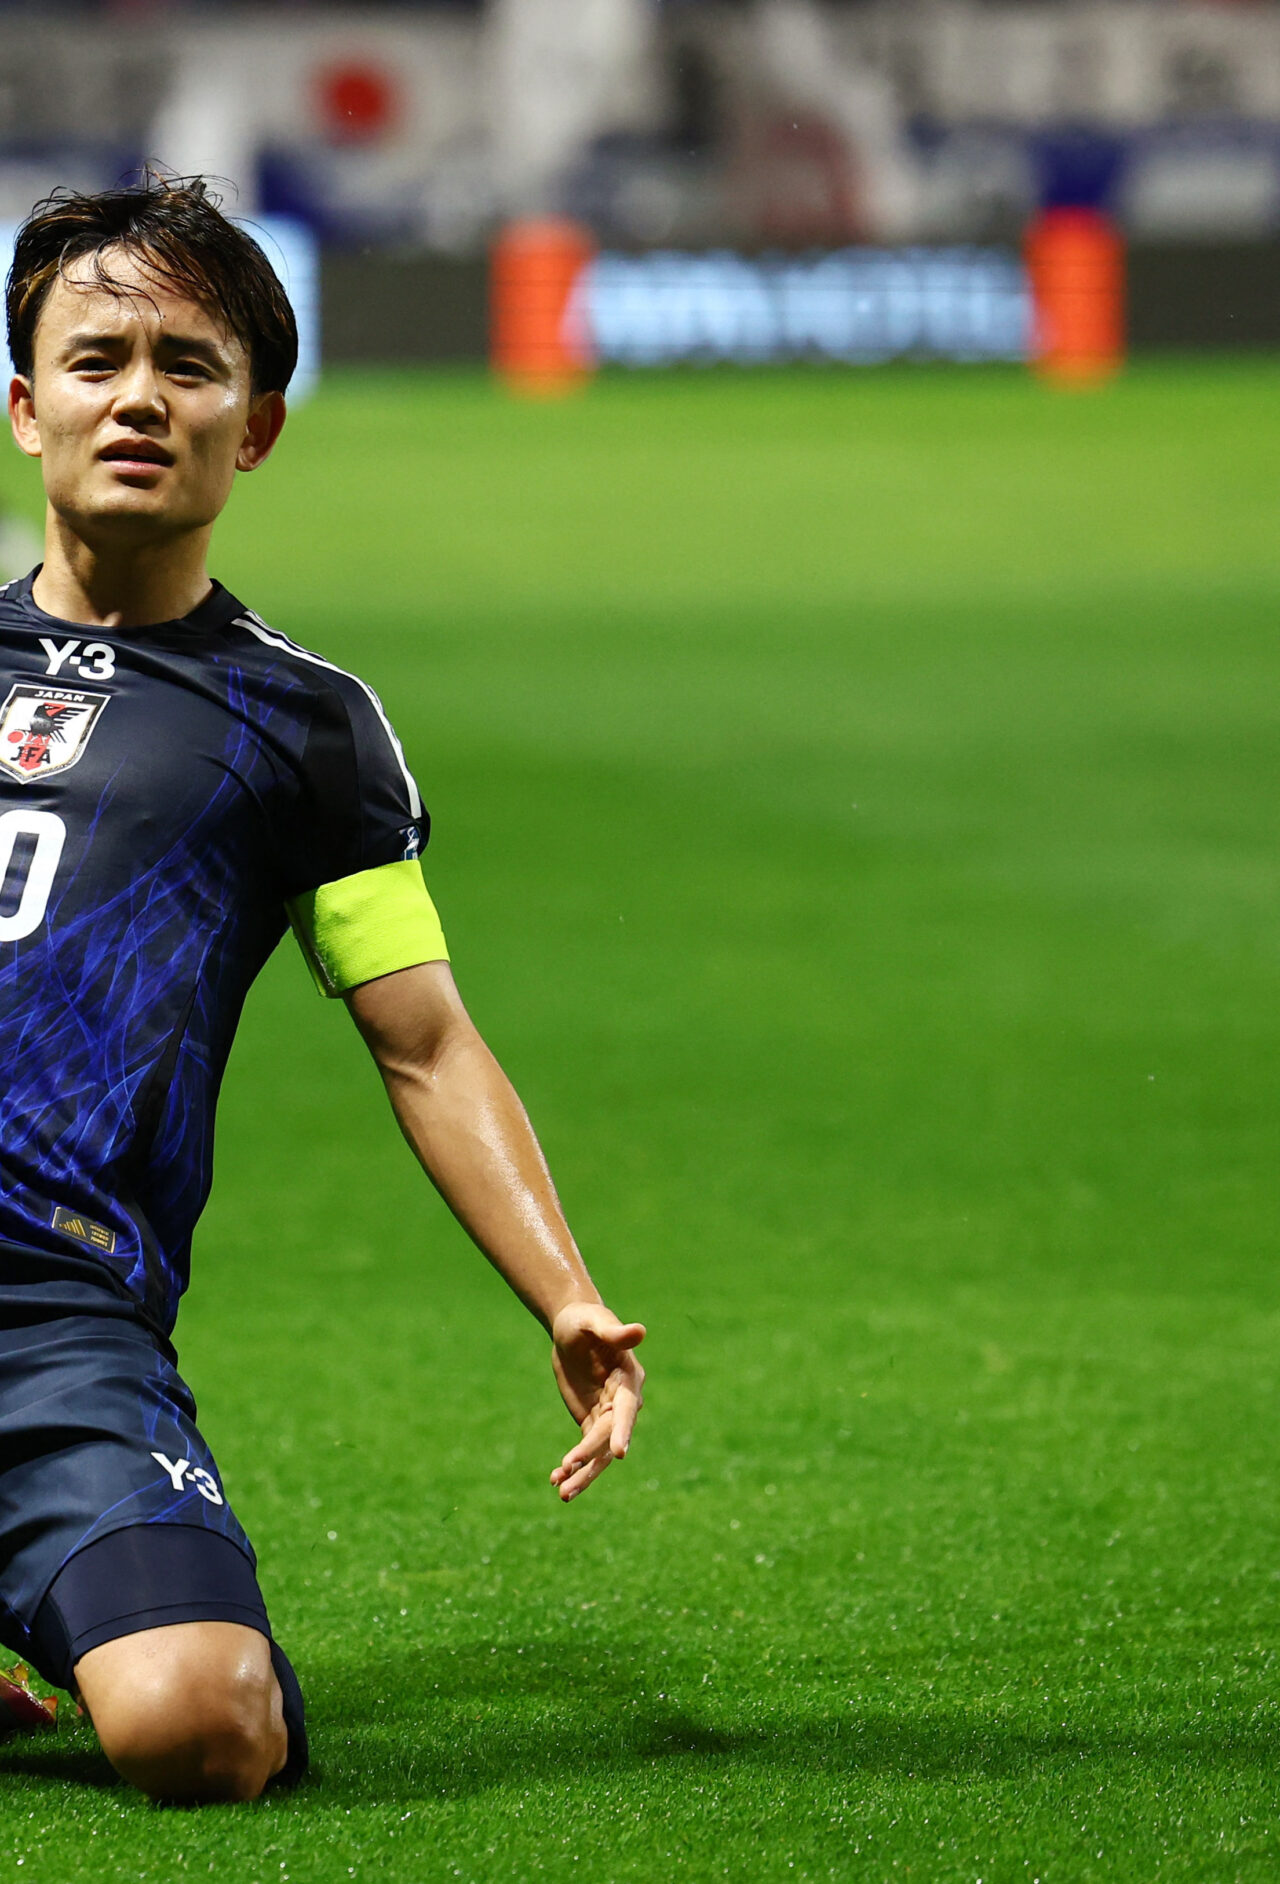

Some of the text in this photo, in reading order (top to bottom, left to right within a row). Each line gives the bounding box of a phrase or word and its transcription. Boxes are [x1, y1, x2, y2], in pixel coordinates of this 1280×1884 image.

[38, 638, 116, 680] Y-3
[34, 690, 85, 703] JAPAN
[10, 746, 52, 765] JFA
[151, 1451, 223, 1506] Y-3
